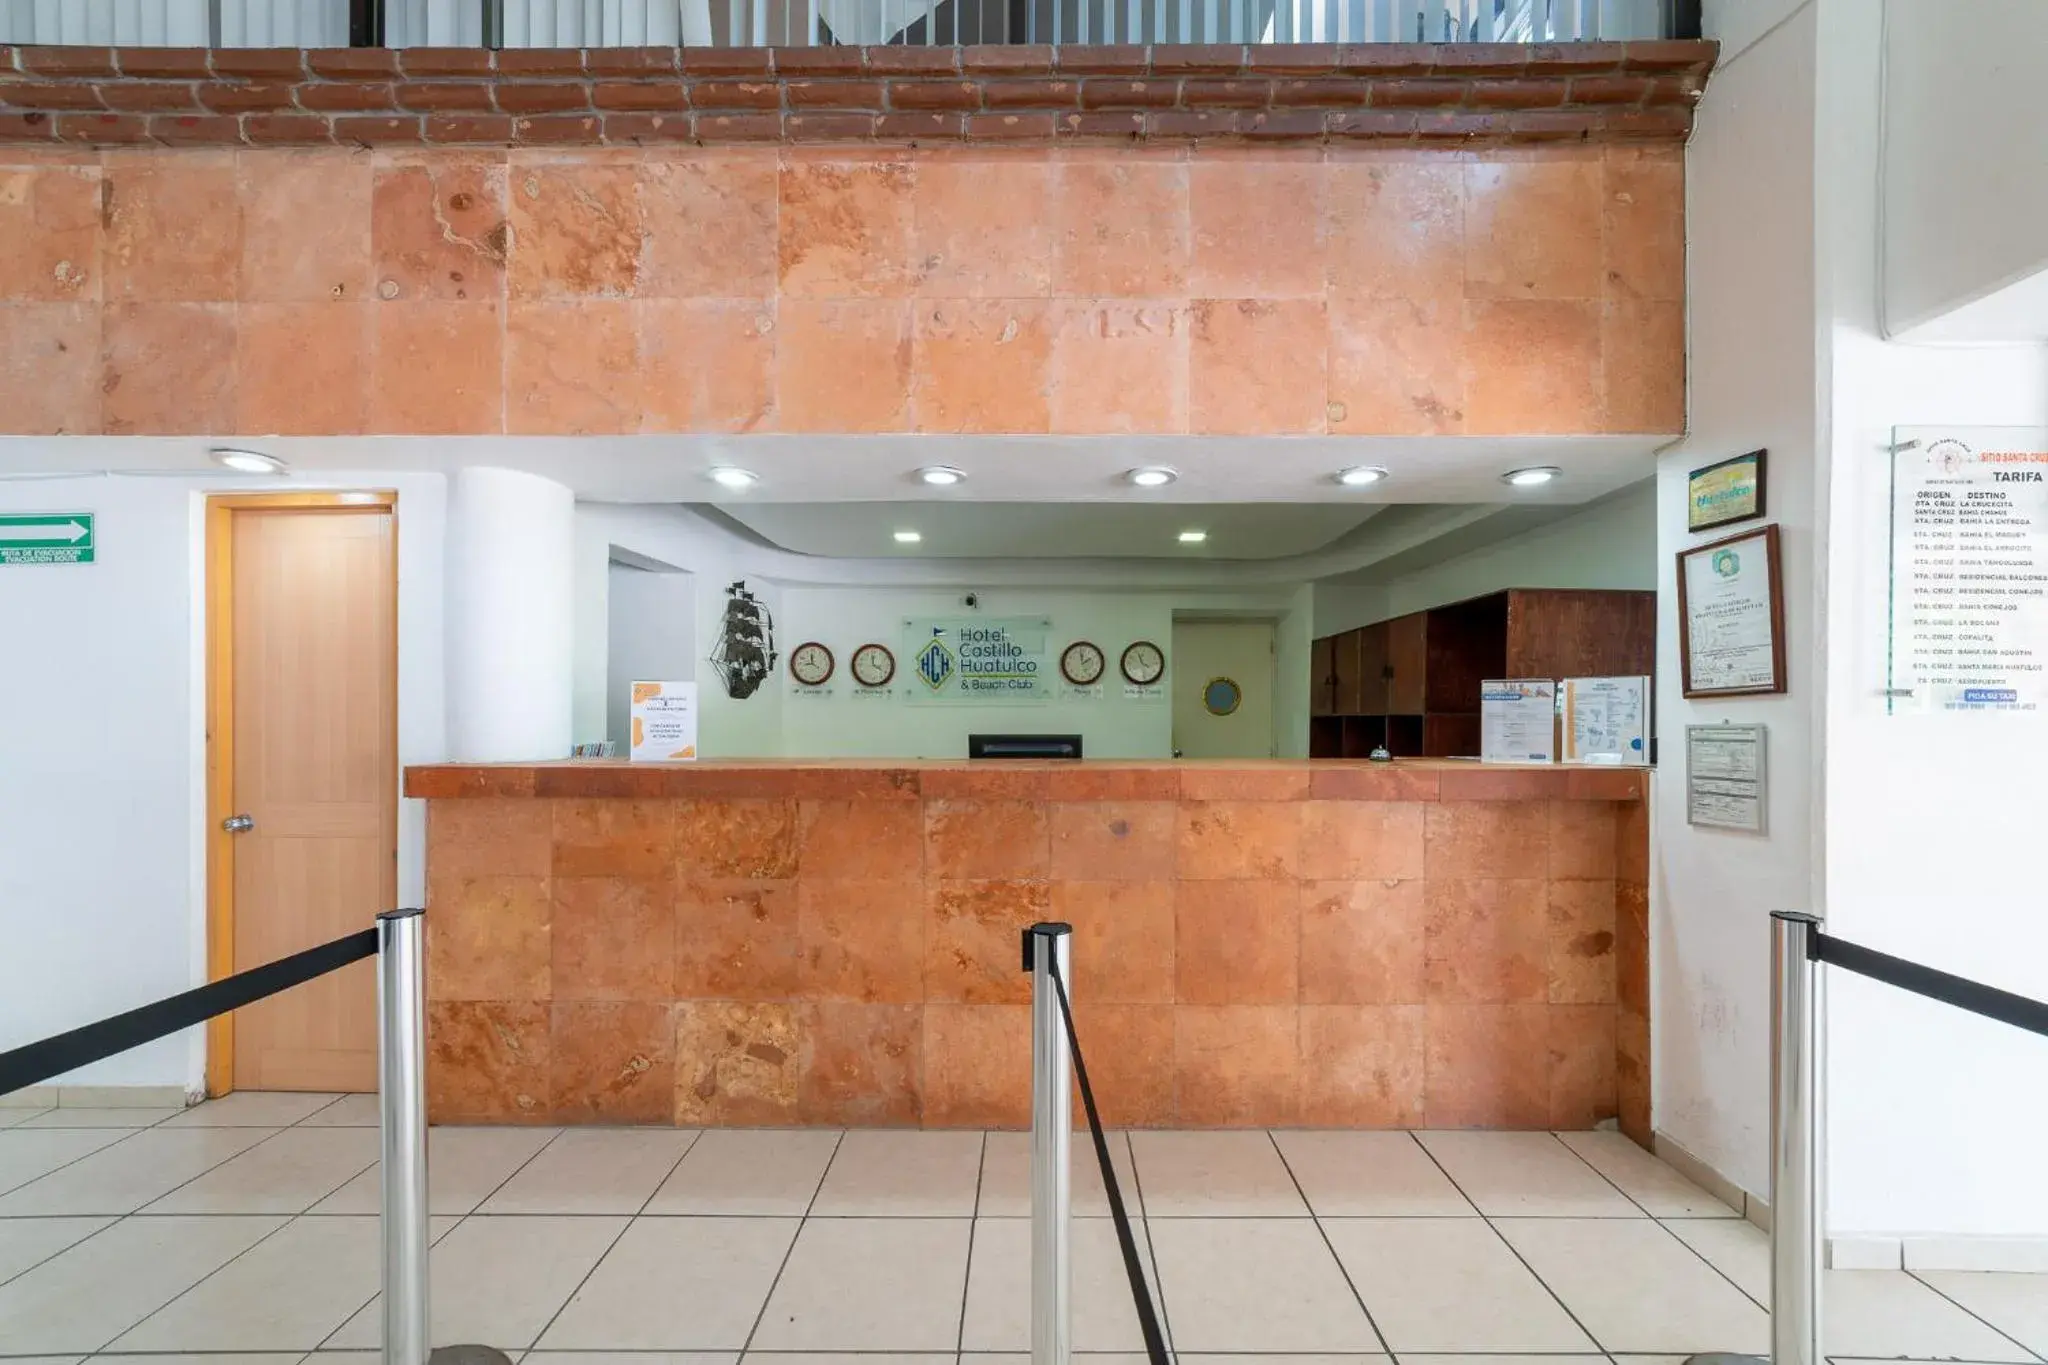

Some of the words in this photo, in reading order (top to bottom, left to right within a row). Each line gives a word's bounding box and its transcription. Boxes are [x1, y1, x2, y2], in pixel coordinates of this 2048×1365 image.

[1993, 471, 2043, 482] TARIFA
[960, 627, 1005, 642] Hotel
[959, 643, 1022, 657] Castillo
[921, 645, 950, 684] HCH
[960, 658, 1037, 673] Huatulco
[960, 681, 969, 690] &
[971, 680, 1005, 690] Beach
[1008, 679, 1033, 690] Club
